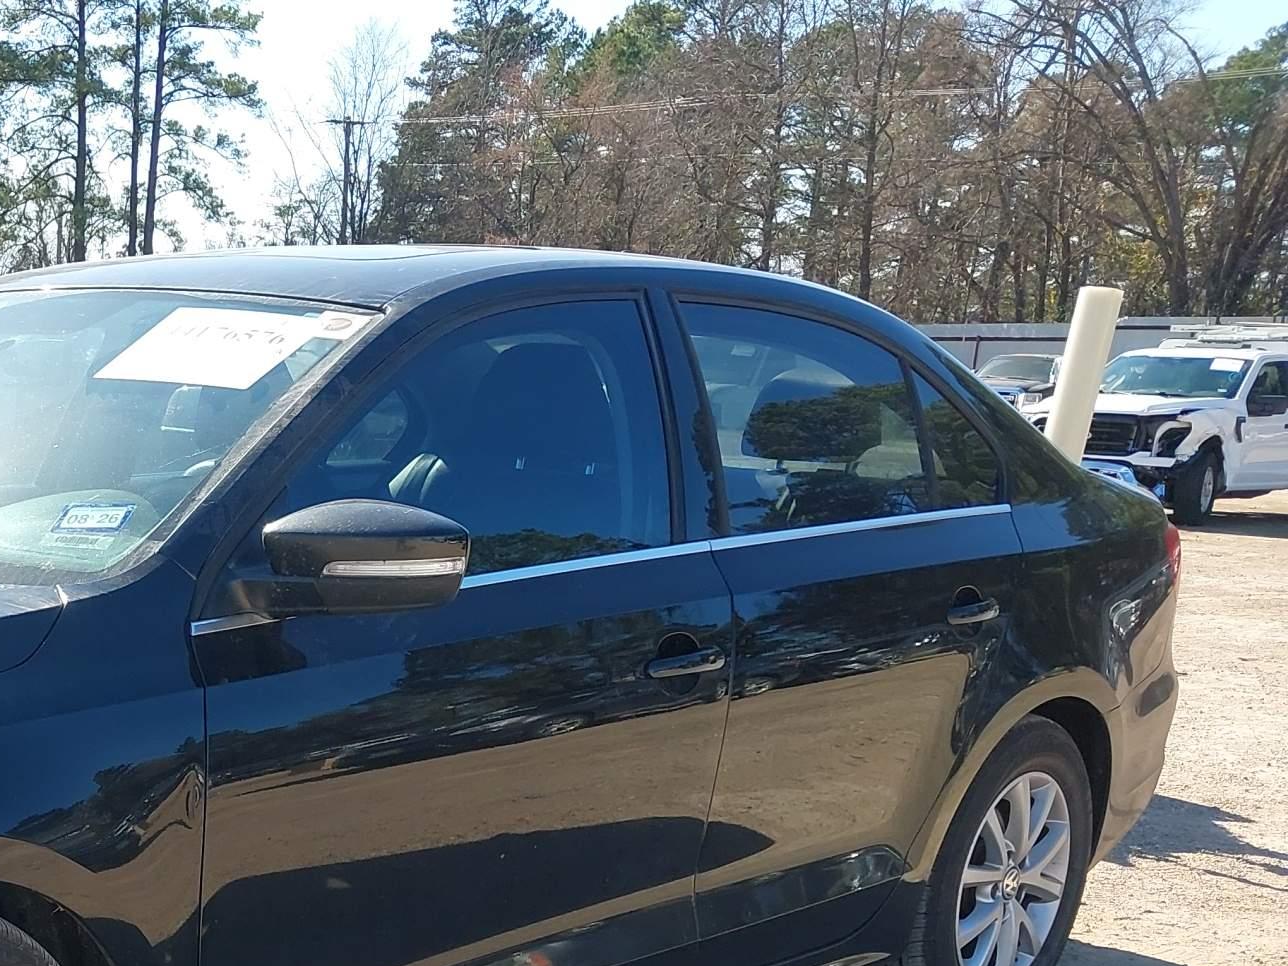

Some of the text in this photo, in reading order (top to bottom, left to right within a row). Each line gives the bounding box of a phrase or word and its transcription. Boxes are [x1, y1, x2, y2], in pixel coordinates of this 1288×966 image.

[170, 325, 286, 345] 176576
[66, 513, 121, 525] 08 26
